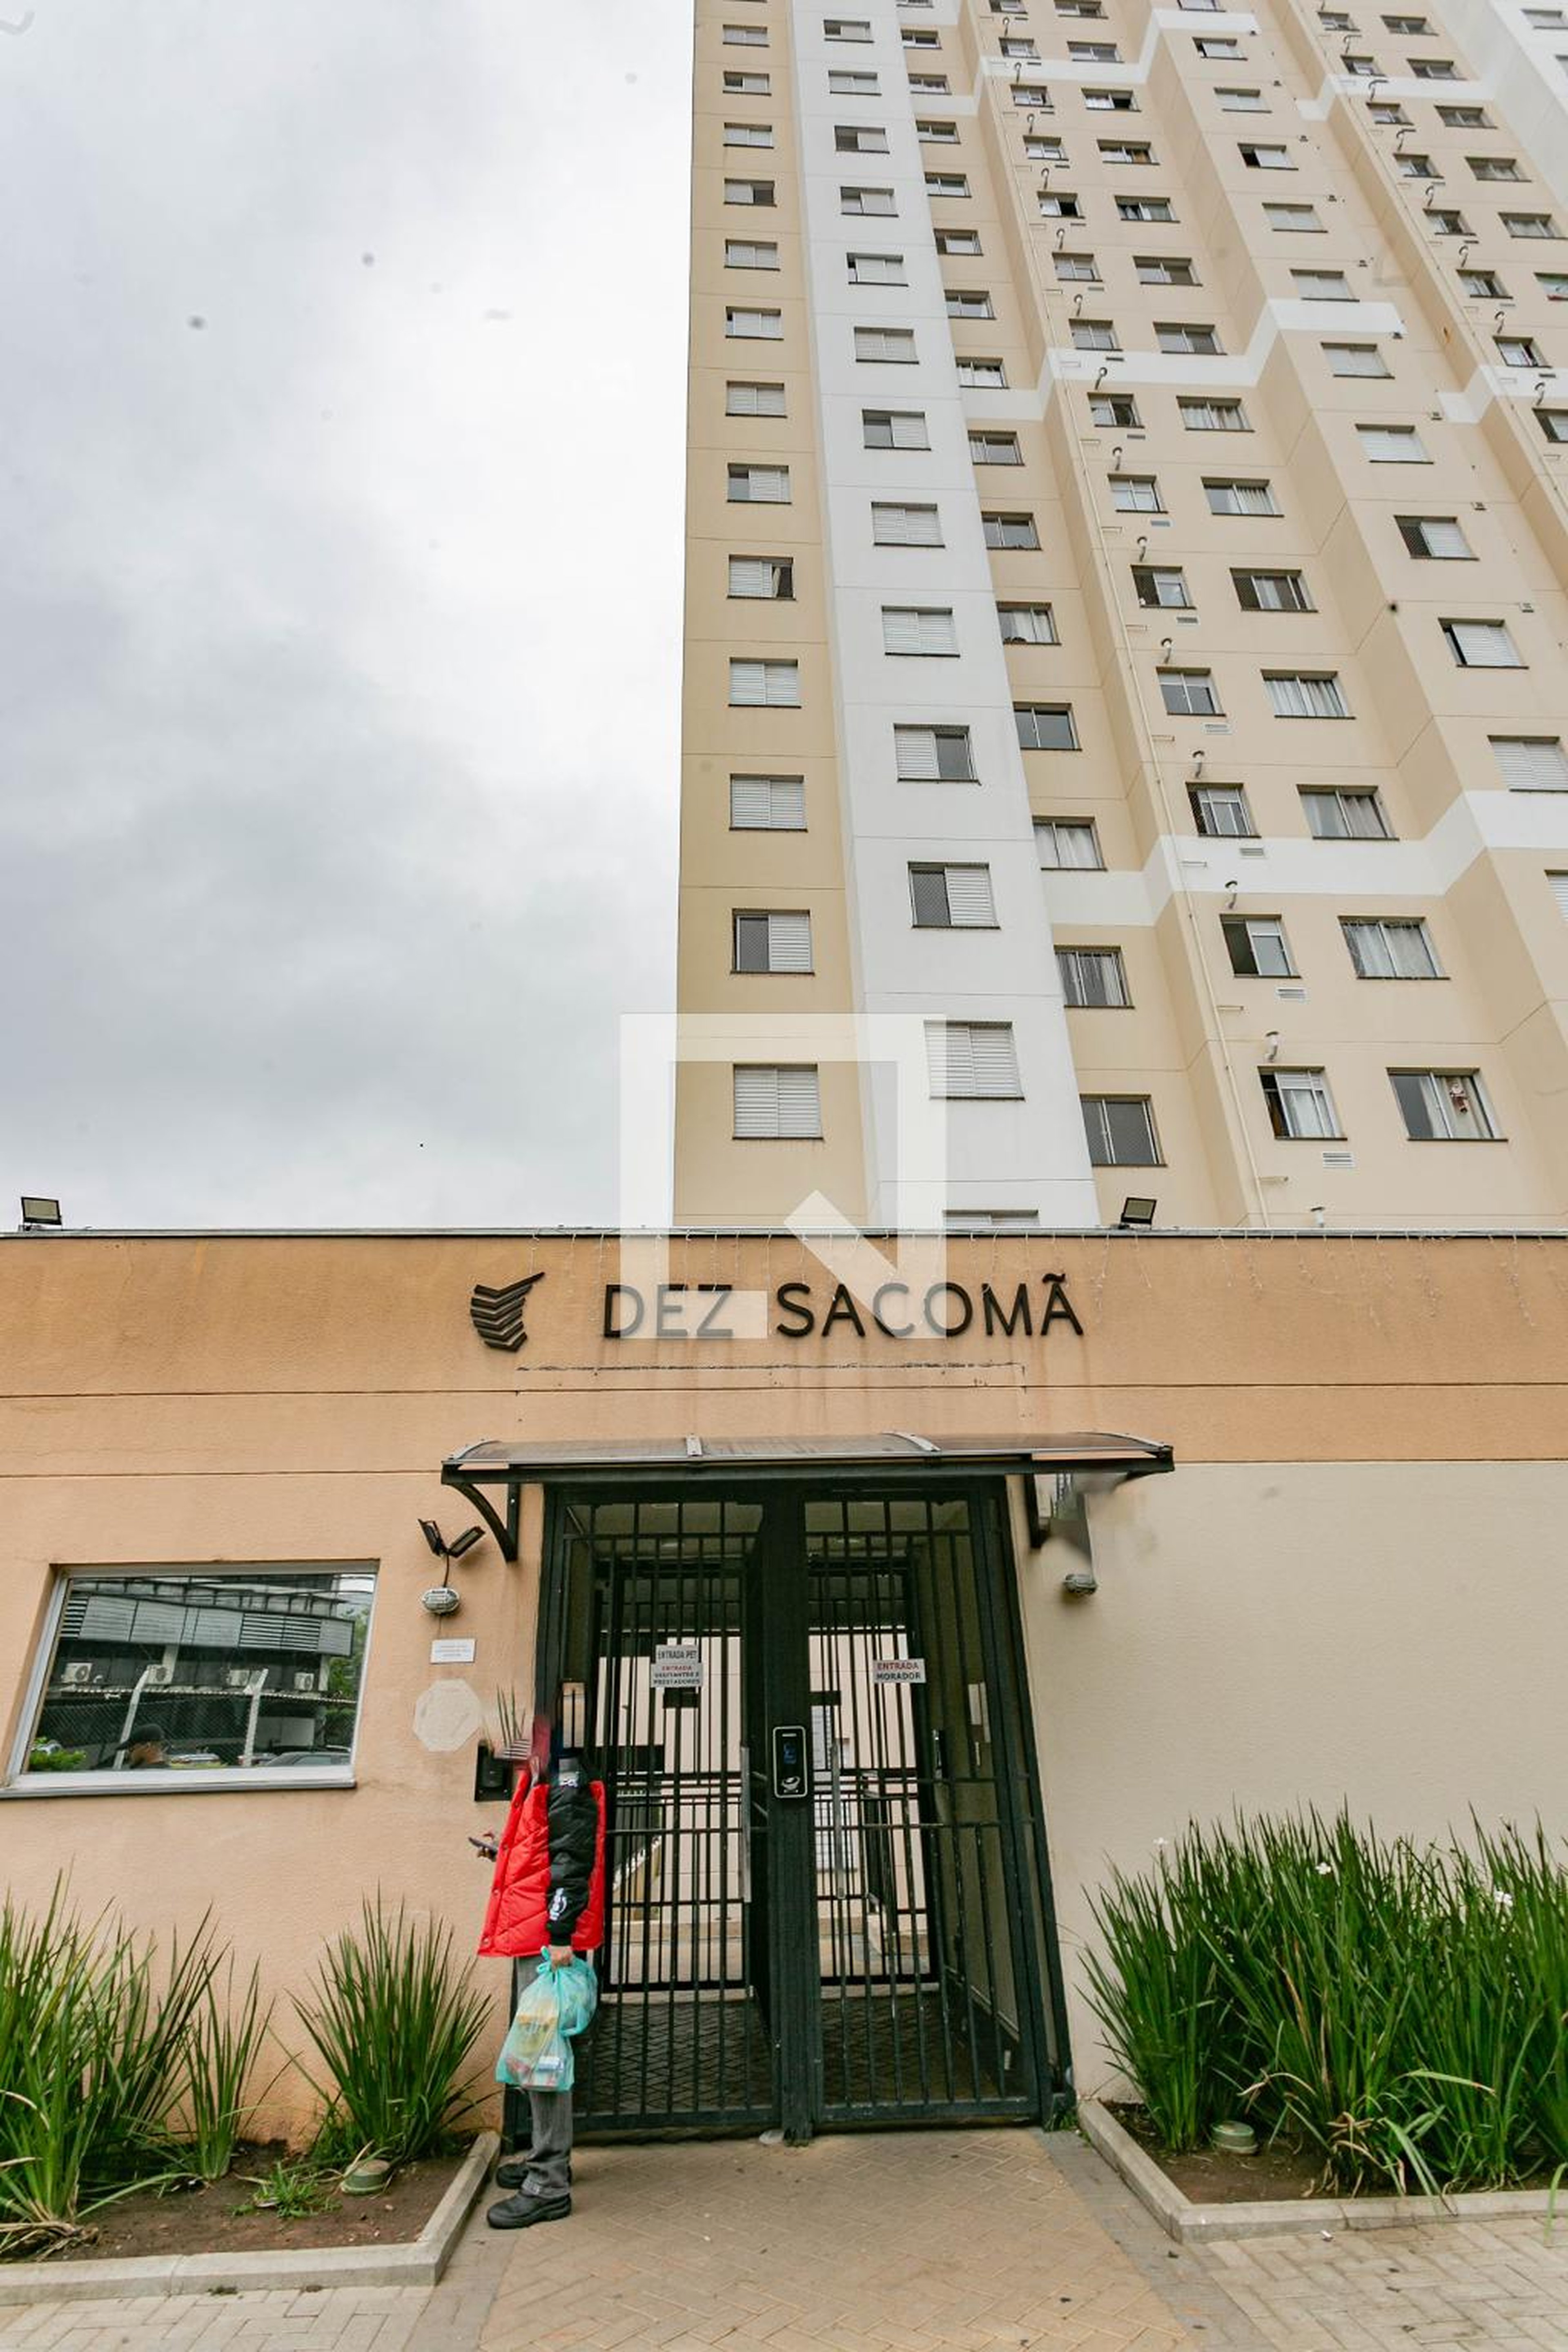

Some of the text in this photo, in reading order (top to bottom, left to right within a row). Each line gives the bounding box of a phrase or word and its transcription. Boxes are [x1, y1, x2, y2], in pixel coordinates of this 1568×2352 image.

[604, 1273, 1084, 1338] DEZ SACOMÃ
[877, 1662, 920, 1671] ENTRADA
[876, 1672, 921, 1680] MORADOR
